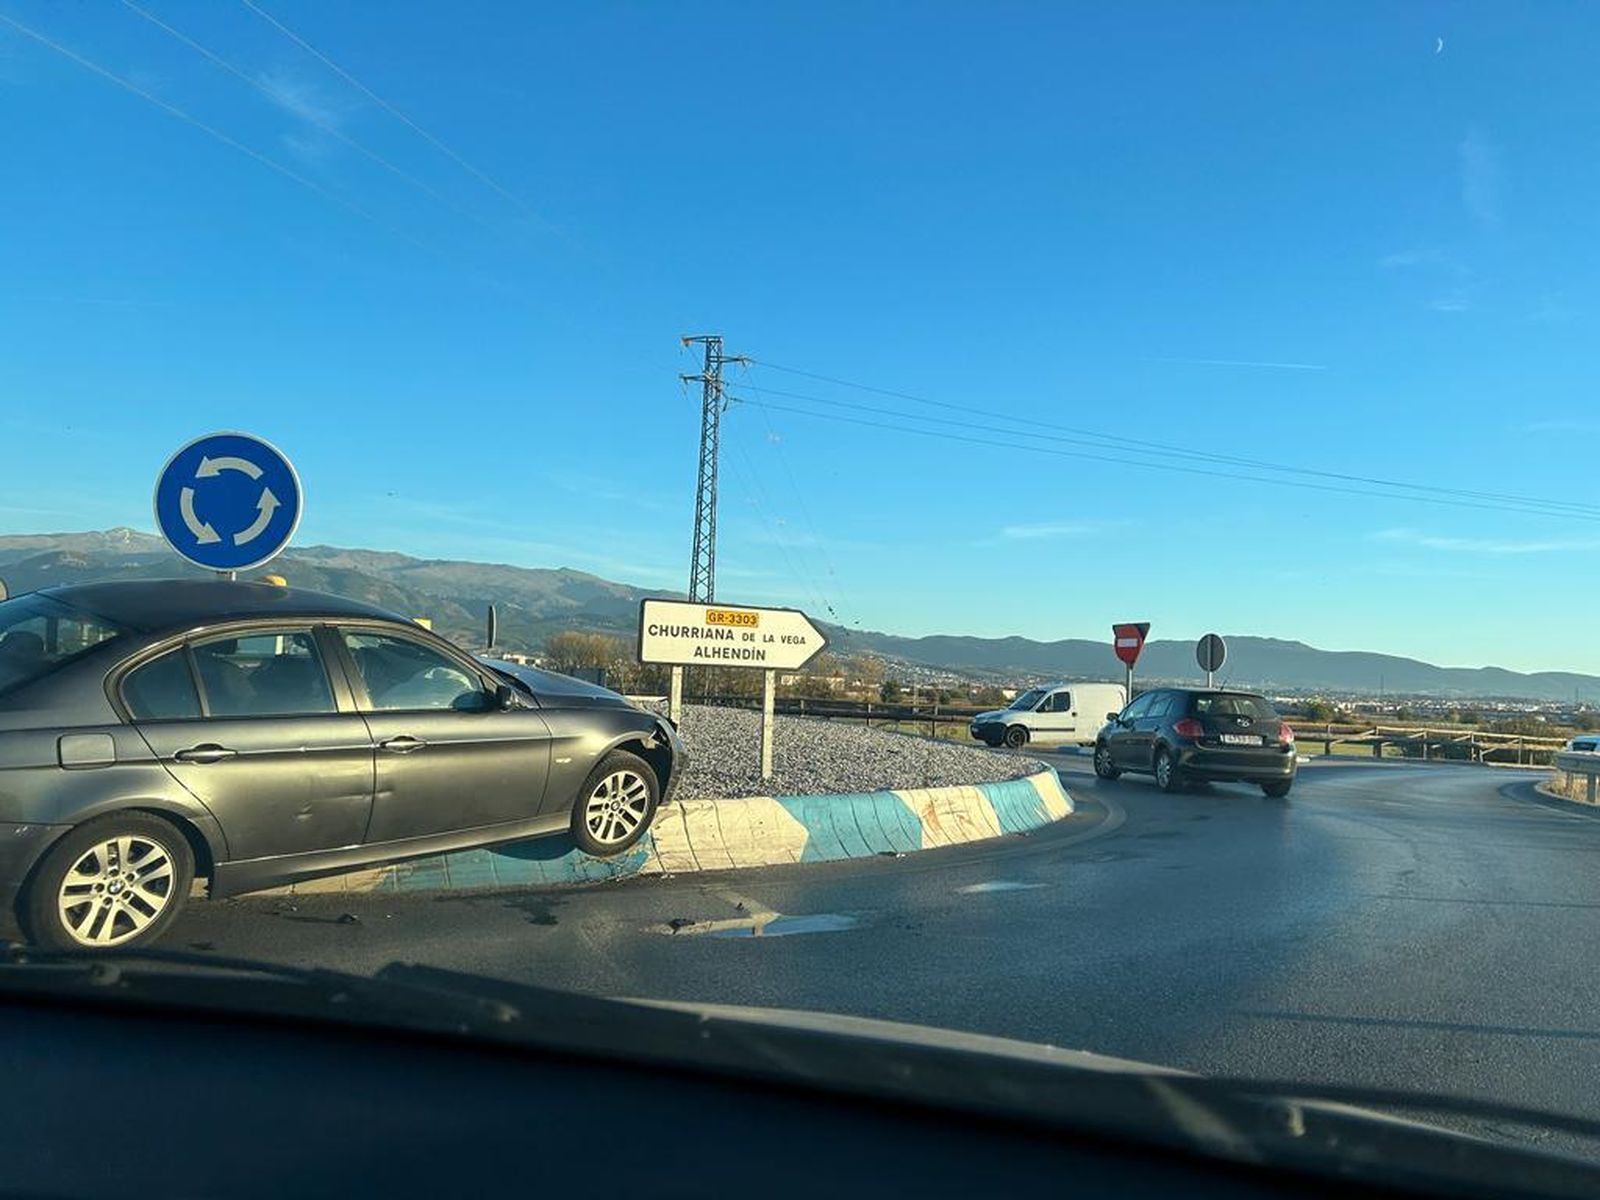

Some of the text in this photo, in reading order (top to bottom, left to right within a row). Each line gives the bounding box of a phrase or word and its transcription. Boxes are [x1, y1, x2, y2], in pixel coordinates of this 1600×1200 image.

[708, 611, 757, 625] GR-3303
[648, 625, 806, 645] CHURRIANA DE LA VEGA
[694, 646, 766, 661] ALHENDÍN
